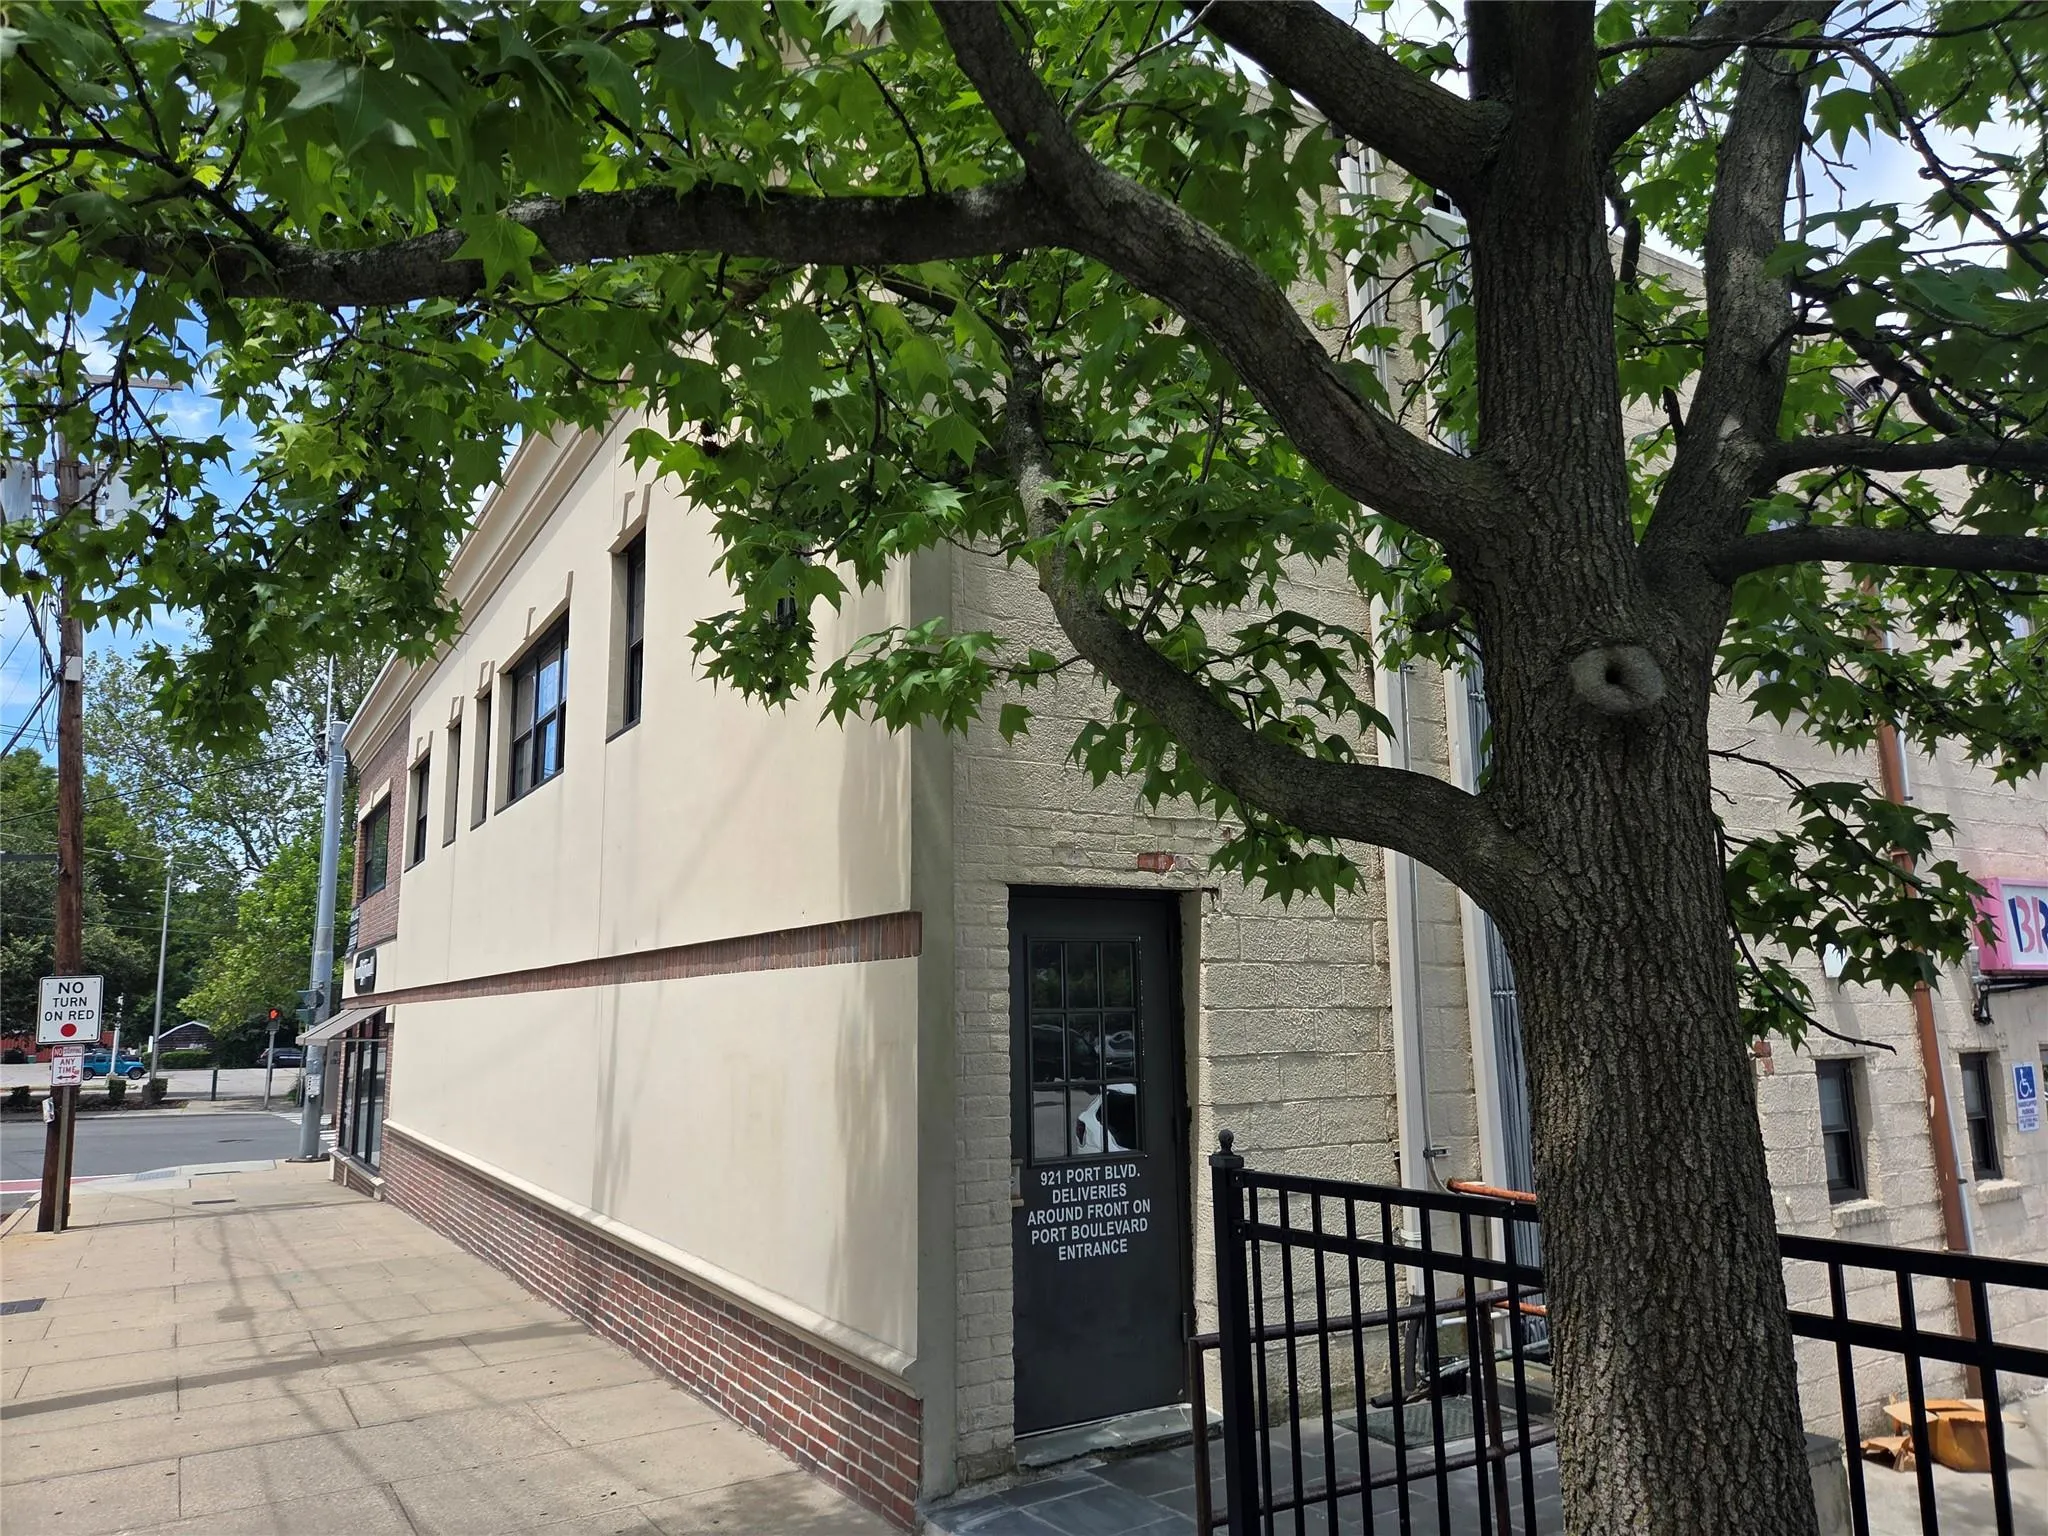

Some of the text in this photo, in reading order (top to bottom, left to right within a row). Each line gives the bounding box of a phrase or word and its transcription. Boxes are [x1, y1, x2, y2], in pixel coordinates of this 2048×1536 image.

[58, 981, 84, 995] NO
[52, 997, 87, 1008] TURN
[44, 1010, 95, 1022] ON RED
[54, 1047, 63, 1057] NO
[60, 1058, 75, 1066] ANY
[1040, 1164, 1140, 1186] 921 PORT BLVD.
[1052, 1183, 1127, 1204] DELIVERIES
[1027, 1199, 1150, 1226] AROUND FRONT ON
[1031, 1218, 1148, 1245] PORT BOULEVARD
[1058, 1238, 1127, 1261] ENTRANCE
